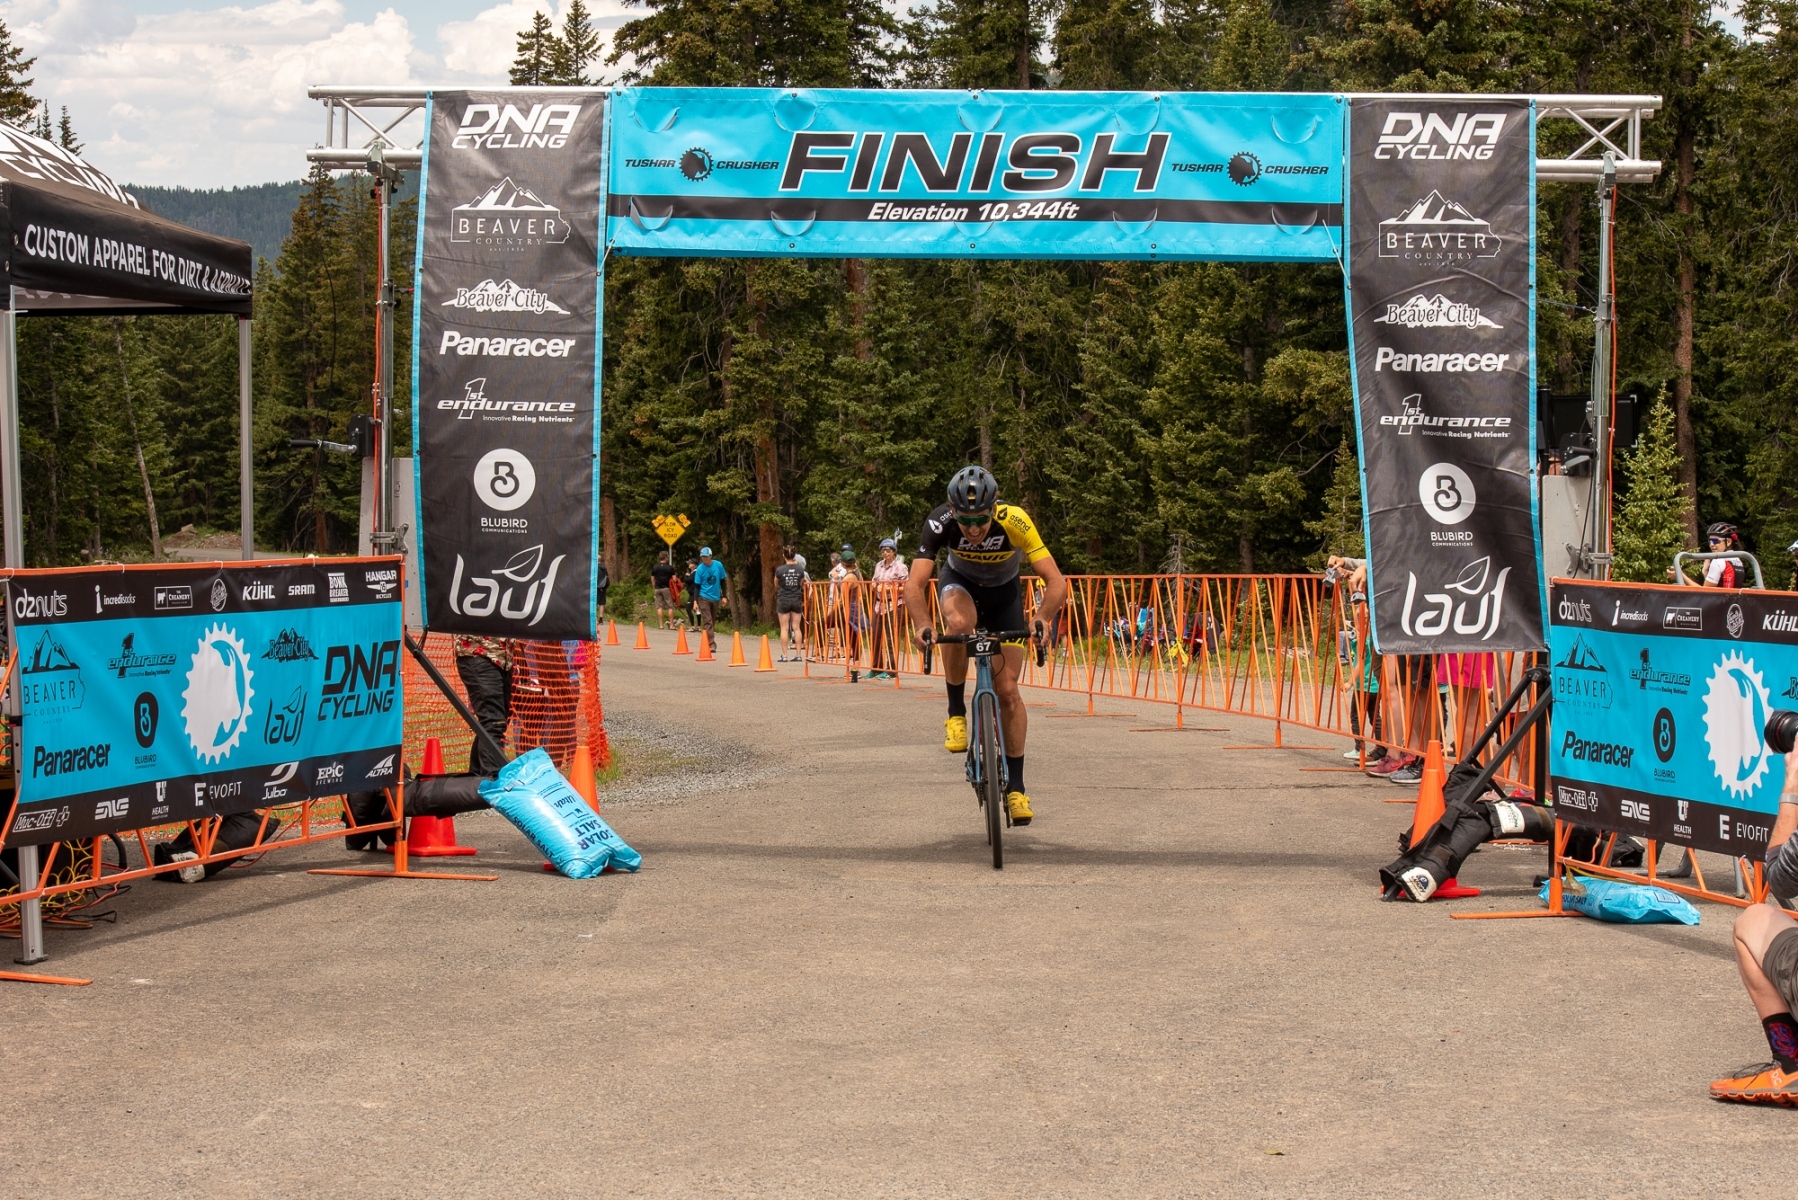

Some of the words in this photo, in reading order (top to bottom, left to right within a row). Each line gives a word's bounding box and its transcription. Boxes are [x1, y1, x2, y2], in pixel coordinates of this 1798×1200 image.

[457, 104, 582, 134] DNA
[1378, 112, 1507, 144] DNA
[451, 133, 568, 149] CYCLING
[1374, 144, 1496, 160] CYCLING
[624, 158, 676, 168] TUSHAR
[715, 160, 780, 170] CRUSHER
[778, 131, 1172, 193] FINISH
[1171, 163, 1224, 173] TUSHAR
[1264, 165, 1329, 175] CRUSHER
[867, 202, 969, 221] Elevation
[978, 201, 1080, 222] 10,344ft
[459, 218, 556, 235] BEAVER
[475, 237, 543, 246] COUNTRY
[1386, 233, 1486, 249] BEAVER
[24, 223, 90, 265] CUSTOM
[93, 236, 151, 276] APPAREL
[152, 249, 177, 283] FOR
[178, 257, 203, 290] DIRT
[201, 265, 210, 291] &
[1404, 252, 1474, 260] COUNTRY
[457, 288, 511, 308] Beaver
[514, 288, 548, 313] City
[1387, 304, 1442, 324] Beaver
[1445, 304, 1480, 329] City
[439, 330, 576, 358] Panaracer
[1374, 347, 1509, 373] Panaracer
[437, 398, 576, 412] endurance
[512, 414, 537, 424] Racing
[1379, 413, 1512, 428] endurance
[1448, 430, 1472, 440] Racing
[480, 517, 528, 528] BLUBIRD
[1430, 531, 1474, 541] BLUBIRD
[956, 552, 1010, 561] MAVIC
[365, 569, 397, 582] HANGAR
[242, 580, 276, 601] KÜHL
[288, 583, 316, 596] SRAM
[449, 553, 567, 627] lauf
[1401, 566, 1513, 641] lauf
[1676, 614, 1700, 623] CREAMERY
[975, 641, 992, 652] 67
[107, 652, 177, 670] endurance
[321, 640, 400, 696] DNA
[1630, 666, 1691, 687] endurance
[23, 680, 76, 705] BEAVER
[1559, 676, 1607, 699] BEAVER
[318, 689, 395, 722] CYCLING
[1561, 730, 1635, 768] Panaracer
[32, 743, 111, 779] Panaracer
[134, 754, 157, 764] BLUBIRD
[364, 766, 393, 779] ALTRA
[209, 781, 243, 800] EVOFIT
[262, 786, 287, 800] Julbo
[554, 794, 577, 808] Utah
[15, 809, 57, 830] Muc-Off
[574, 819, 602, 837] SALT
[513, 816, 536, 841] SOLAR
[537, 839, 555, 858] SALT
[1673, 823, 1692, 835] HEALTH
[1736, 822, 1769, 842] EVOFIT
